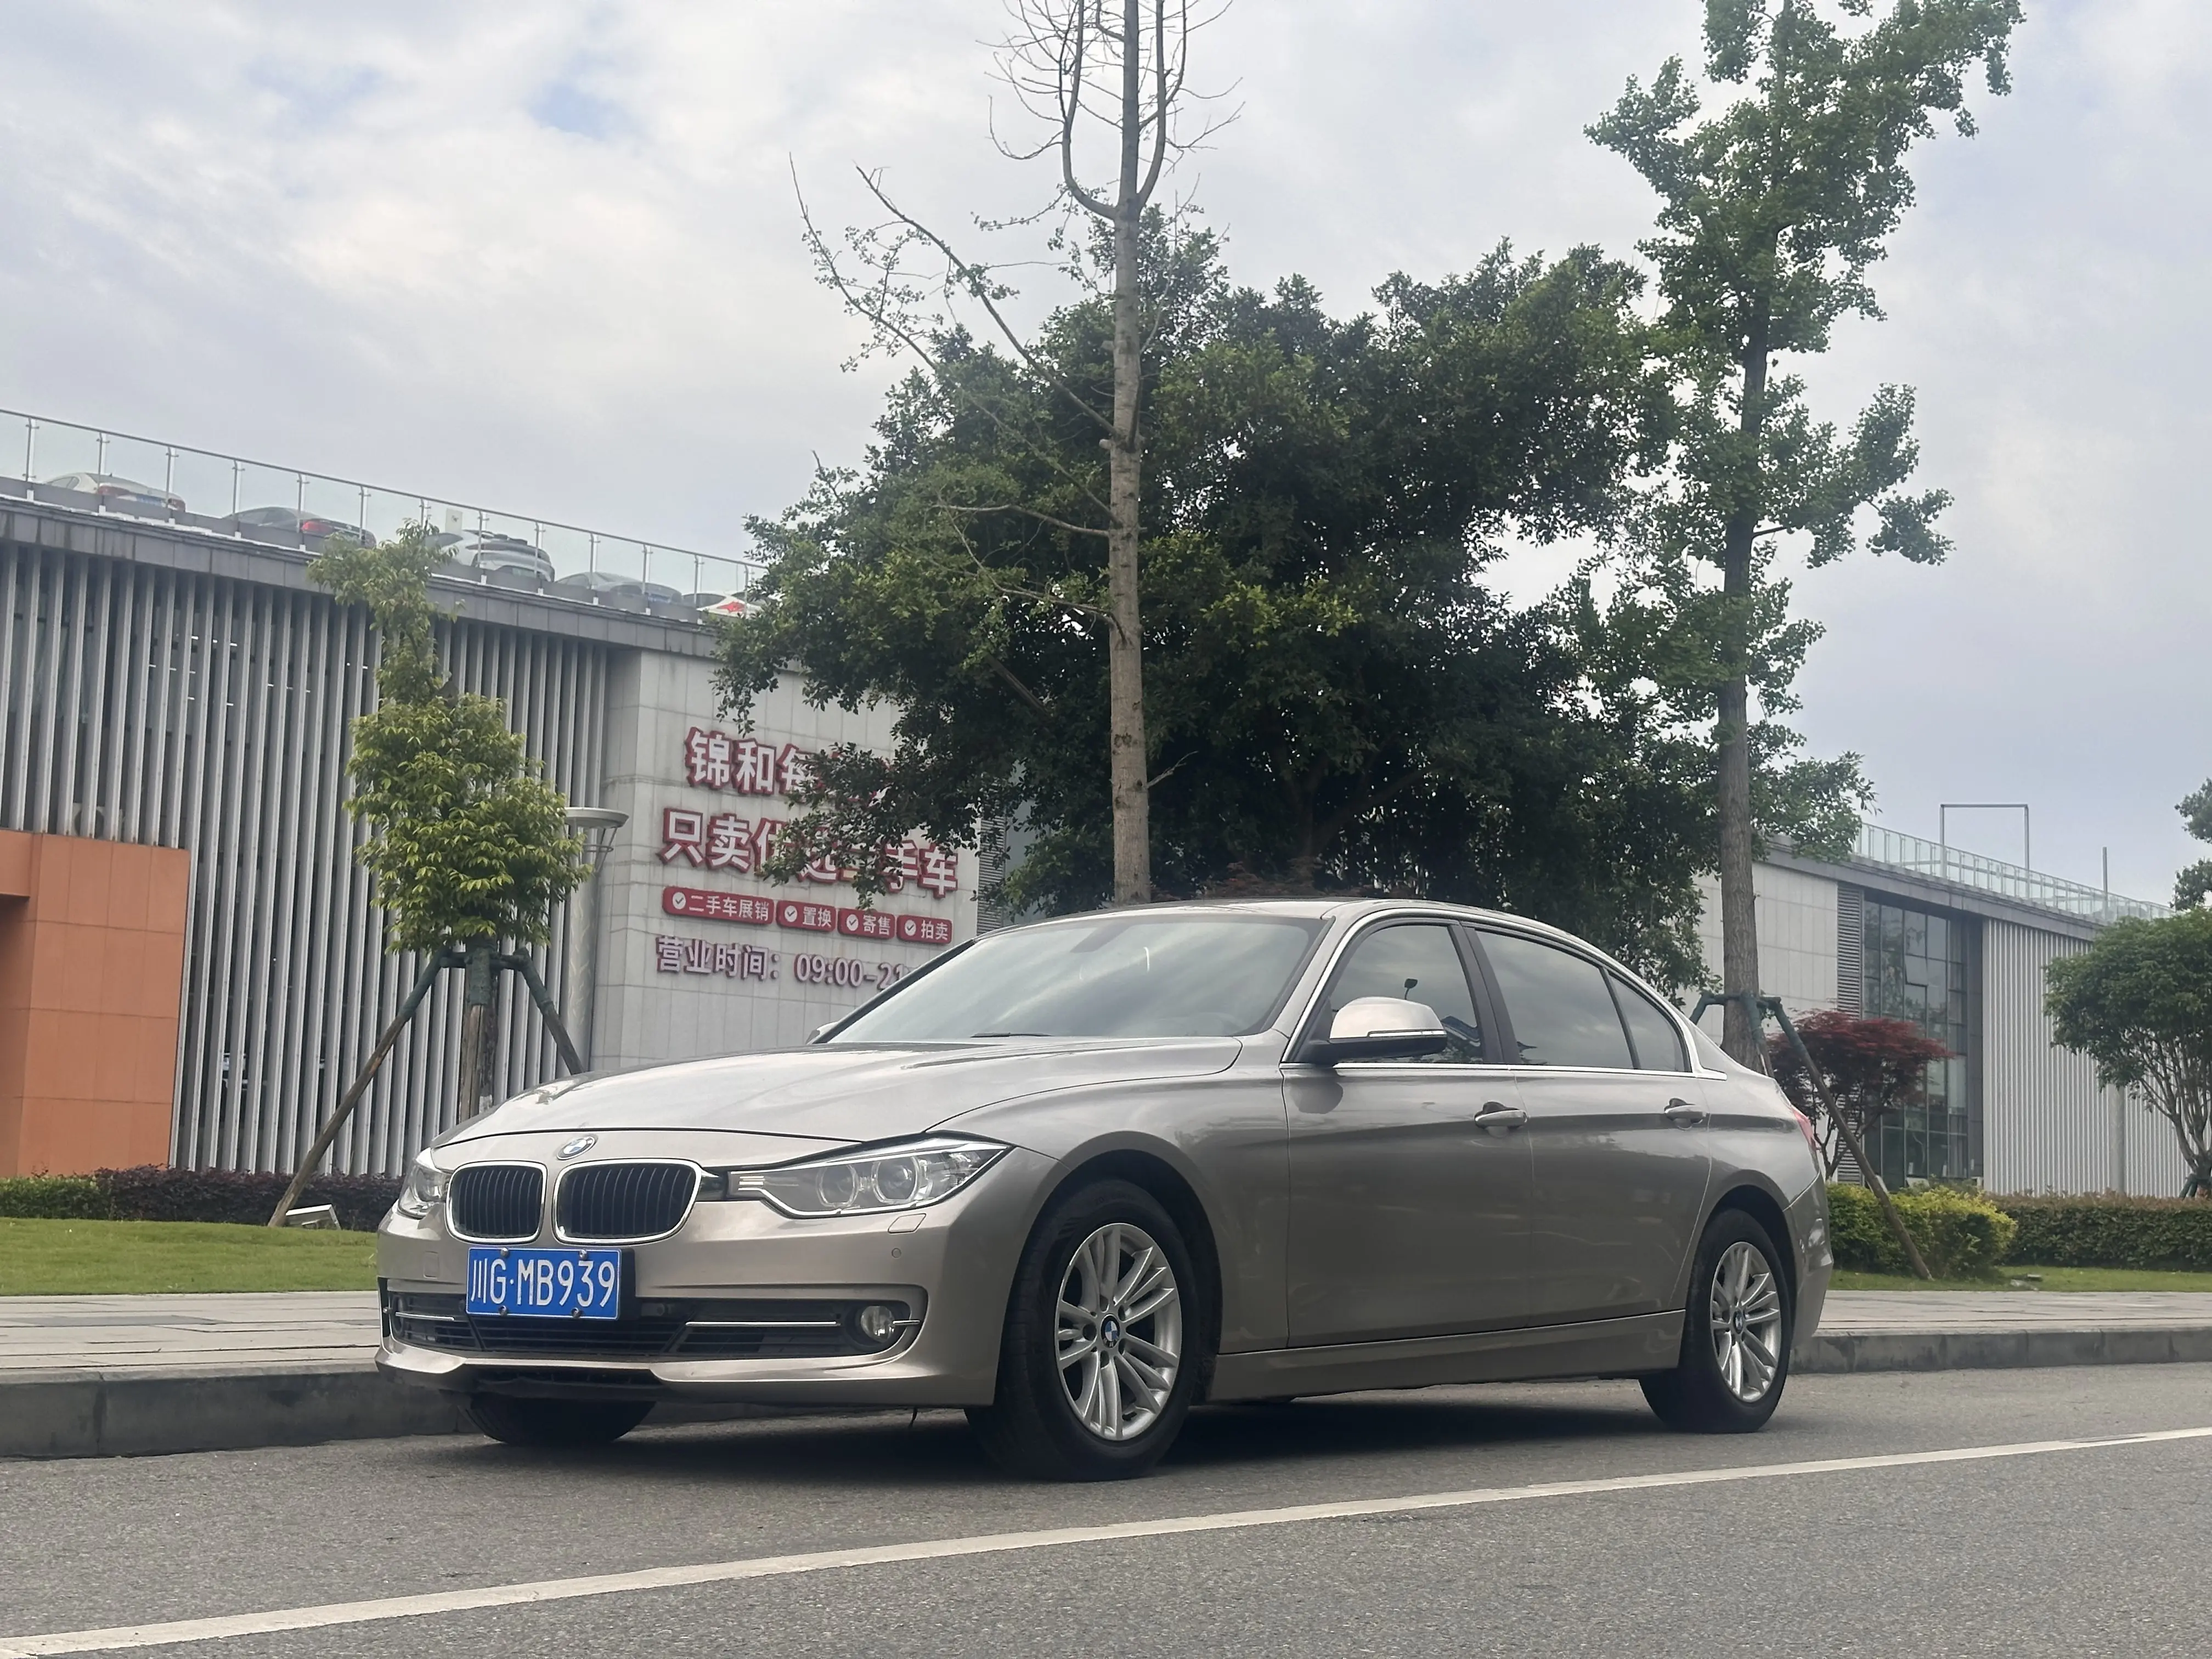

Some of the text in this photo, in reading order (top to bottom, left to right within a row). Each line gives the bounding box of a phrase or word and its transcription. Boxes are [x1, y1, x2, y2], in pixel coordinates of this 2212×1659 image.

[689, 895, 949, 940] 二手车展销 置换 寄售 拍卖
[471, 1258, 615, 1307] 川G·MB939
